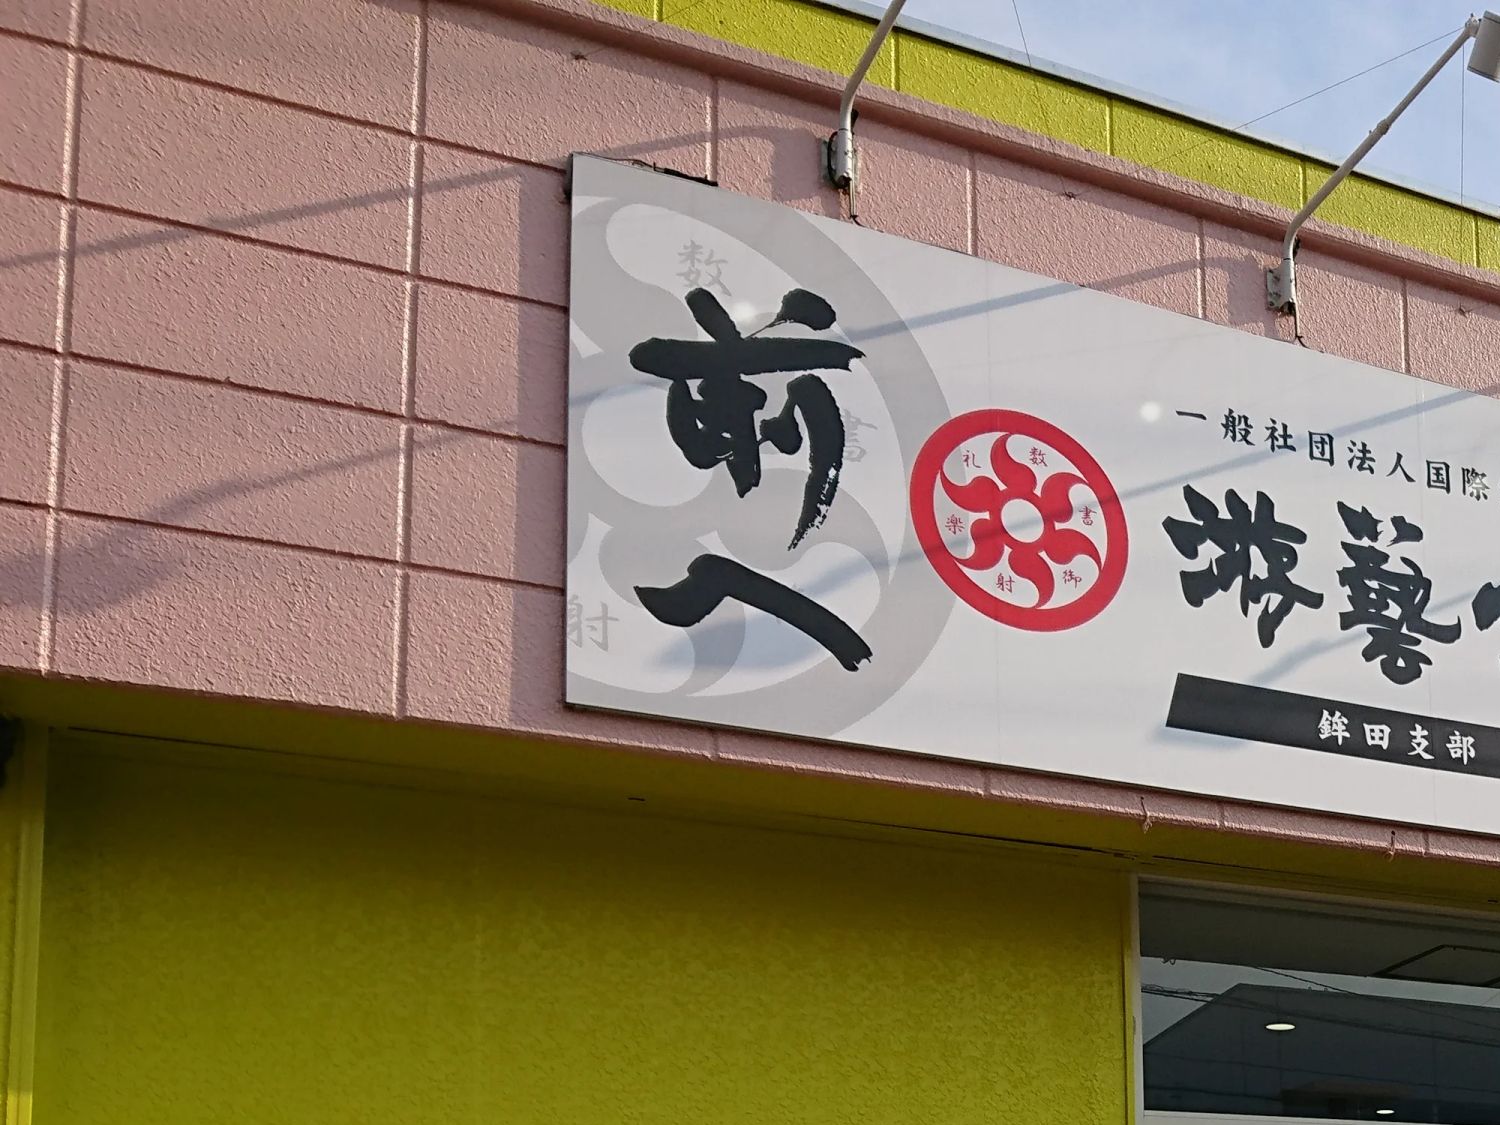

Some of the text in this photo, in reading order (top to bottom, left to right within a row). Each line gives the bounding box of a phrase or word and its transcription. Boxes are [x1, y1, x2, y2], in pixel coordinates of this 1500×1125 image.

[1028, 446, 1048, 468] 数
[995, 572, 1016, 593] 射
[1317, 709, 1476, 766] 鉾田支部
